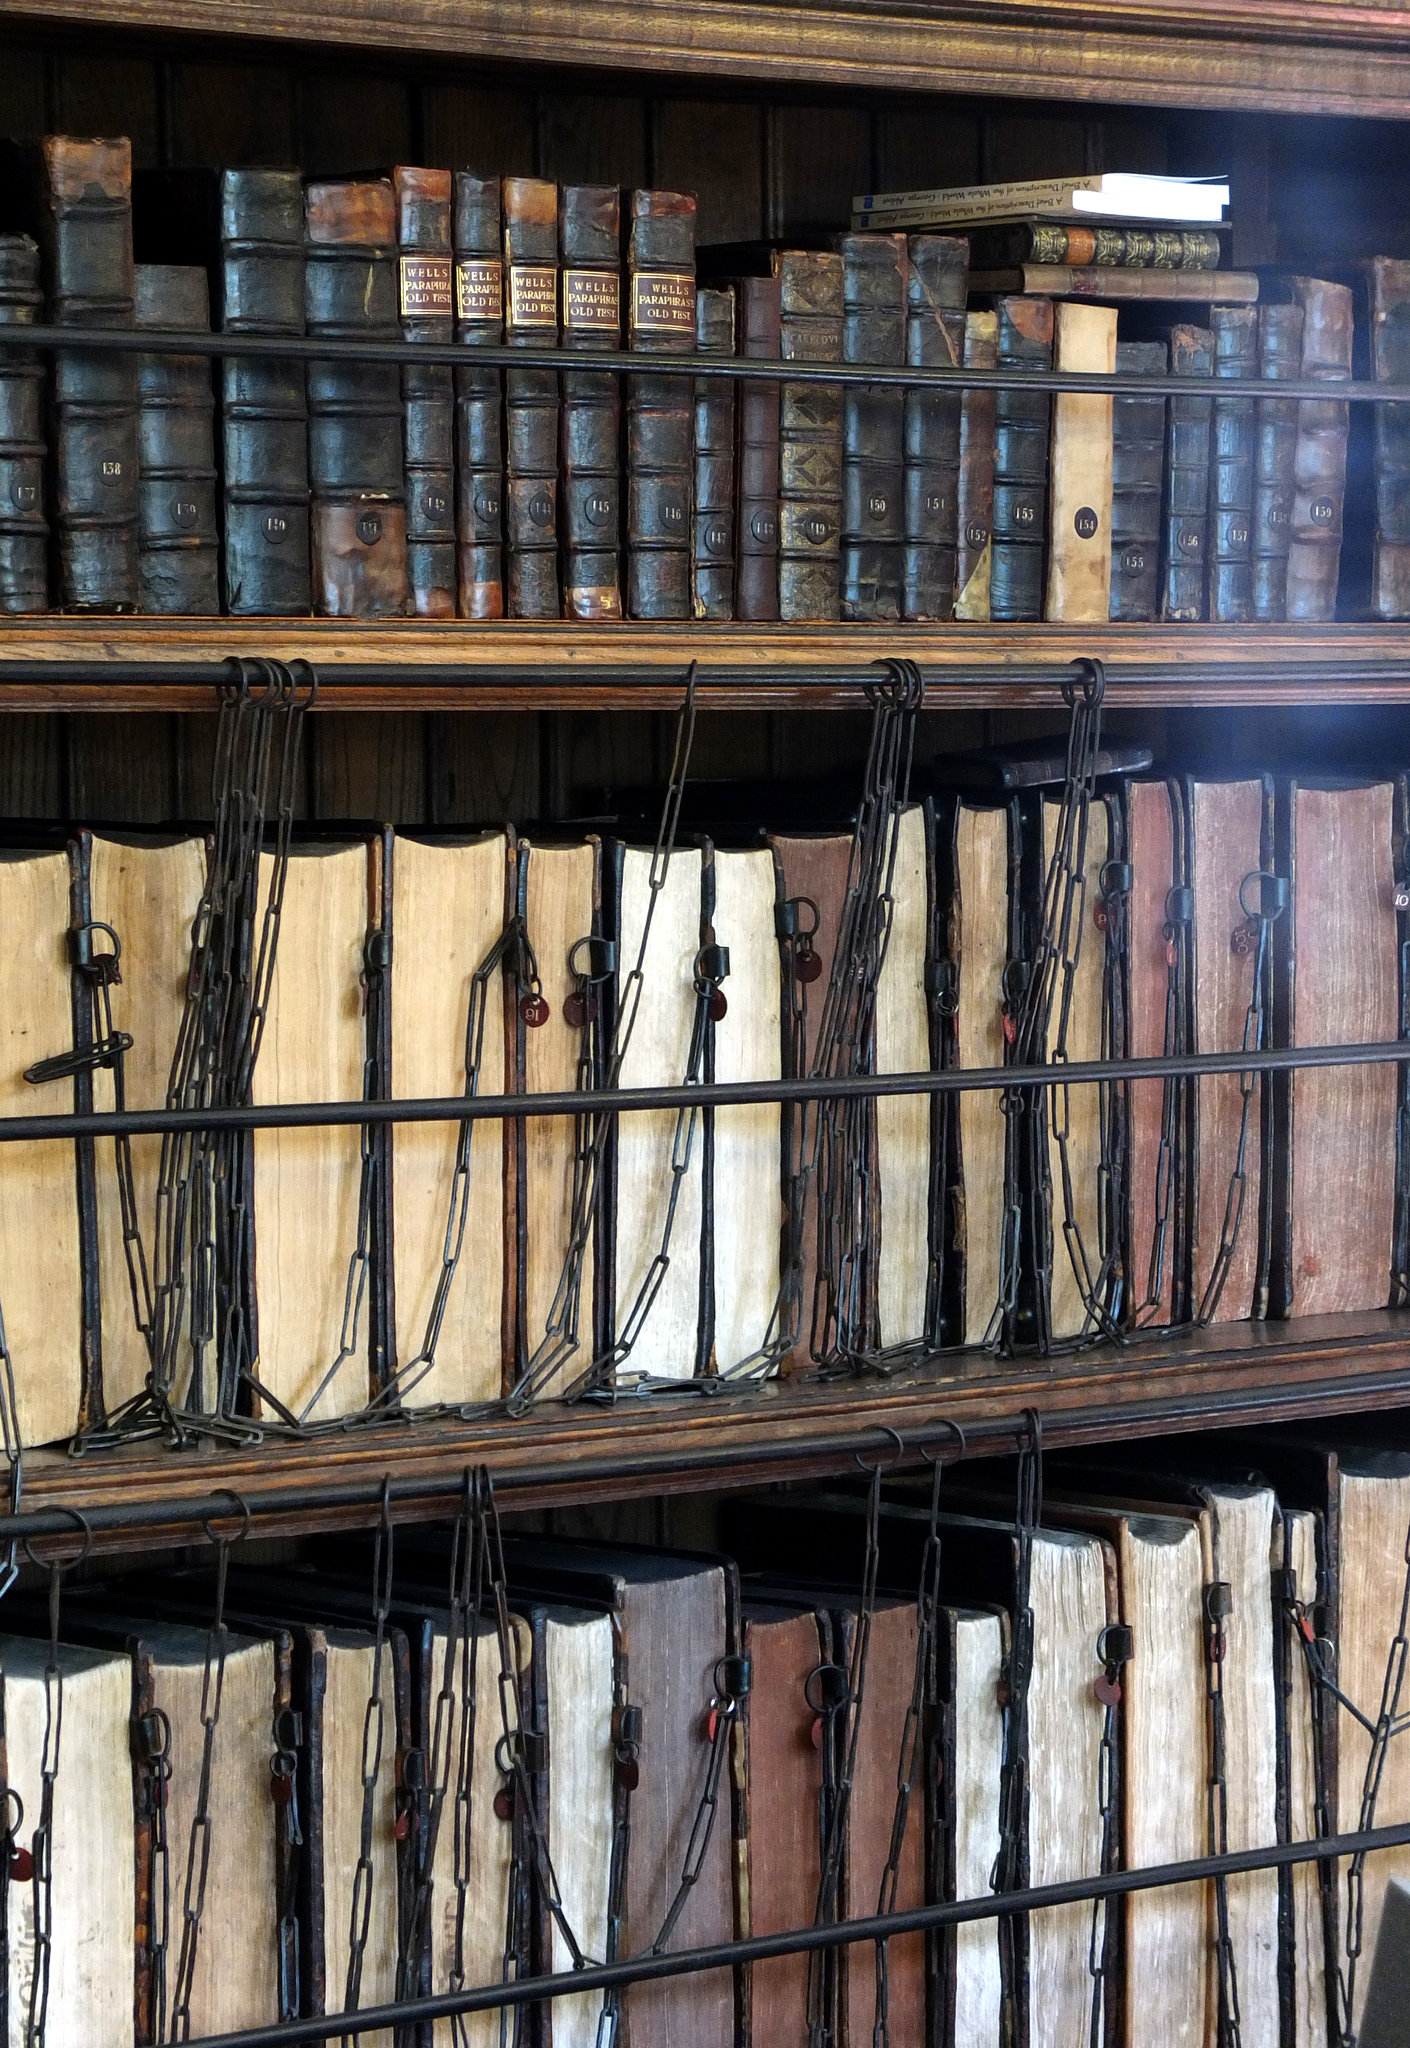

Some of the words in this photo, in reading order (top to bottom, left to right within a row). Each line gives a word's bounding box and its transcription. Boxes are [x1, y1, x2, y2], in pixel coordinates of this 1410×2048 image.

[1015, 183, 1059, 193] Description
[1062, 181, 1080, 190] Brief
[908, 194, 936, 203] George
[942, 192, 964, 201] World
[967, 190, 990, 199] Whole
[995, 200, 1035, 210] Description
[1037, 198, 1054, 208] Brief
[931, 211, 951, 219] World
[953, 207, 974, 217] Whole
[976, 206, 986, 214] the
[407, 268, 448, 278] WELLS
[461, 271, 498, 281] WELLS
[515, 278, 552, 288] WELLS
[574, 282, 614, 293] WELLS
[652, 284, 689, 296] WELLS
[406, 293, 428, 303] OLD
[463, 297, 486, 307] OLD
[516, 303, 538, 313] OLD
[570, 307, 593, 317] OLD
[647, 308, 669, 319] OLD
[102, 462, 121, 475] 138
[429, 497, 445, 511] 142
[482, 500, 498, 513] 143
[593, 500, 609, 513] 145
[870, 499, 886, 512] 150
[927, 497, 945, 510] 151
[665, 507, 681, 520] 146
[1016, 507, 1034, 521] 153
[1315, 505, 1332, 518] 159
[1079, 519, 1094, 532] 154
[970, 528, 987, 542] 152
[1232, 529, 1248, 542] 157
[1182, 535, 1198, 547] 156
[1126, 556, 1144, 568] 155
